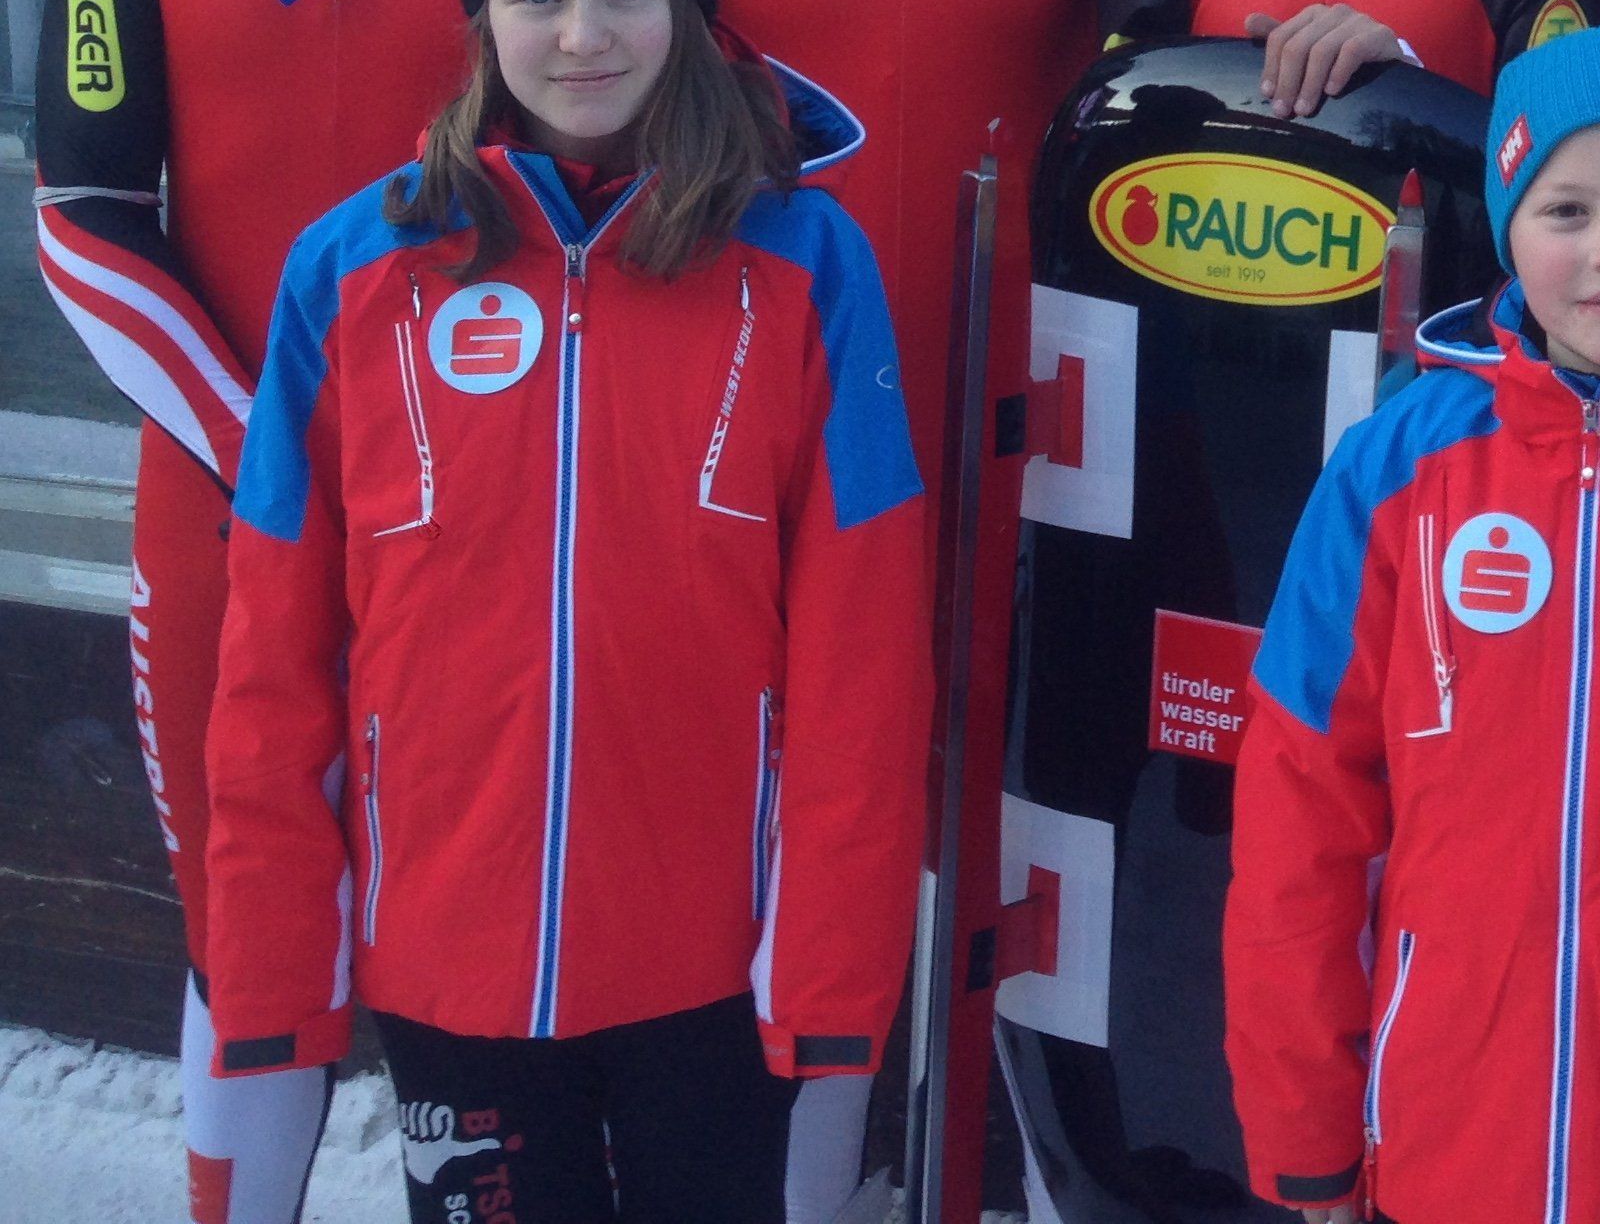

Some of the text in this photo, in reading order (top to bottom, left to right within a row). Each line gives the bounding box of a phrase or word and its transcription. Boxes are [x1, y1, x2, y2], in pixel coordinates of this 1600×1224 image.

[1166, 192, 1362, 272] RAUCH
[1206, 265, 1266, 283] seit 1919
[720, 365, 742, 418] WEST
[1162, 671, 1236, 705] tiroler
[1160, 701, 1244, 733] wasser
[1159, 721, 1216, 754] kraft
